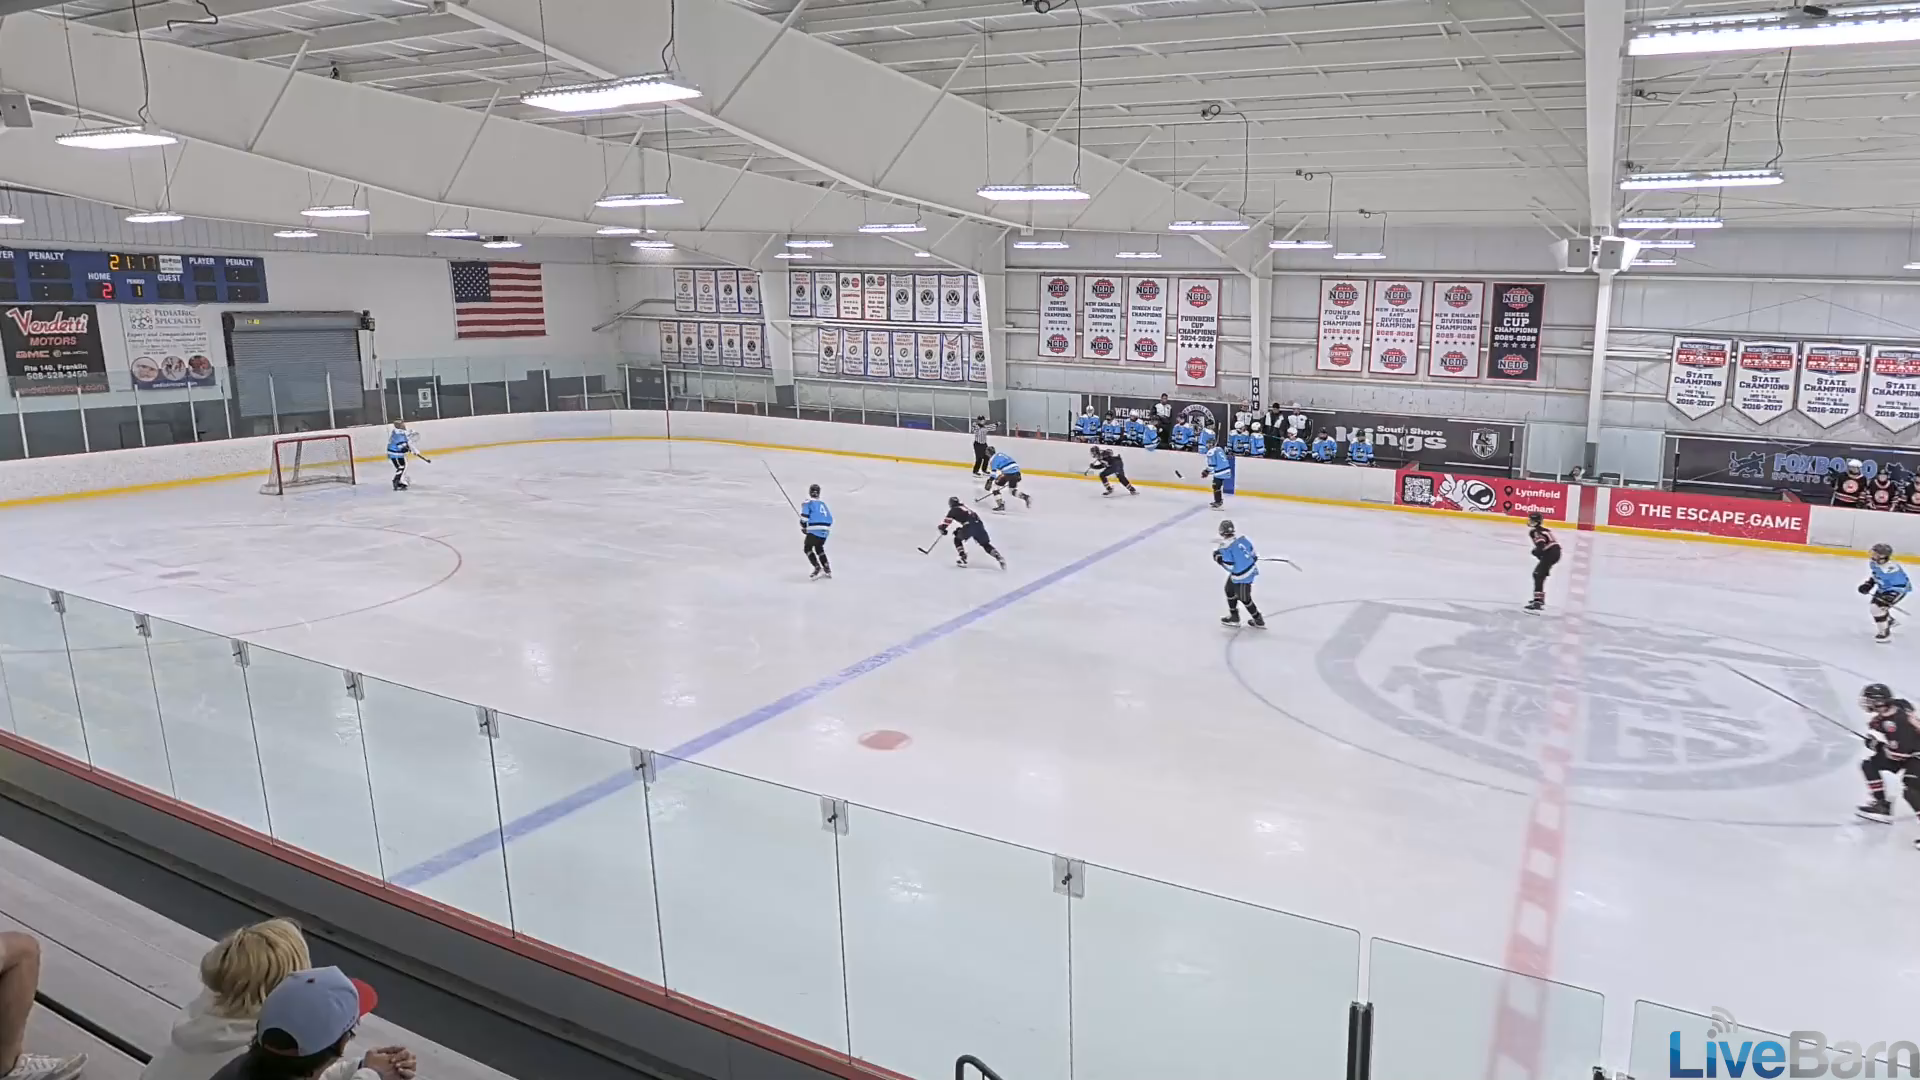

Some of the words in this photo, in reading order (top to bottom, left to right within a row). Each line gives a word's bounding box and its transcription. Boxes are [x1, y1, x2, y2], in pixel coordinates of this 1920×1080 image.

[28, 251, 65, 260] PENALTY
[109, 254, 157, 270] 21:17
[188, 256, 215, 265] PLAYER
[225, 258, 254, 266] PENALTY
[87, 272, 111, 280] HOME
[157, 274, 181, 282] GUEST
[102, 282, 113, 298] 2
[136, 285, 142, 296] 1
[1047, 284, 1069, 293] NCDC
[1091, 285, 1115, 294] NCDC
[1136, 286, 1160, 295] NCDC
[1186, 292, 1212, 301] NCDC
[1328, 291, 1359, 300] NCDC
[1384, 291, 1412, 300] NCDC
[1444, 292, 1472, 301] NCDC
[1502, 293, 1534, 303] NCDC
[6, 307, 89, 336] Vendetti
[1503, 317, 1530, 327] CUP
[1493, 326, 1538, 334] CHAMPIONS
[30, 336, 77, 346] MOTORS
[1046, 340, 1069, 348] NCDC
[1090, 342, 1114, 350] NCDC
[1134, 343, 1158, 352] NCDC
[1380, 355, 1407, 363] NCDC
[1440, 358, 1468, 366] NCDC
[57, 363, 88, 371] Franklin
[1497, 359, 1529, 370] NCDC
[1686, 371, 1713, 379] STATE
[1751, 375, 1780, 383] STATE
[1674, 376, 1722, 387] CHAMPIONS
[1739, 381, 1790, 390] CHAMPIONS
[1817, 377, 1847, 386] STATE
[1886, 381, 1917, 390] STATE
[1803, 383, 1857, 393] CHAMPIONS
[1676, 398, 1715, 407] 2016-2017
[1742, 403, 1782, 411] 2016-2017
[1806, 406, 1849, 414] 2016-2017
[1377, 425, 1408, 435] South
[1410, 427, 1443, 436] Shore
[1335, 426, 1447, 452] Kings
[1773, 453, 1878, 479] FOXBOO
[1772, 472, 1820, 484] SPORTS
[1515, 488, 1560, 499] Lynnfield
[819, 503, 828, 518] 4
[1514, 503, 1555, 513] Dedham
[1639, 503, 1672, 519] THE
[1676, 506, 1745, 525] ESCAPE
[1749, 513, 1802, 530] GAME
